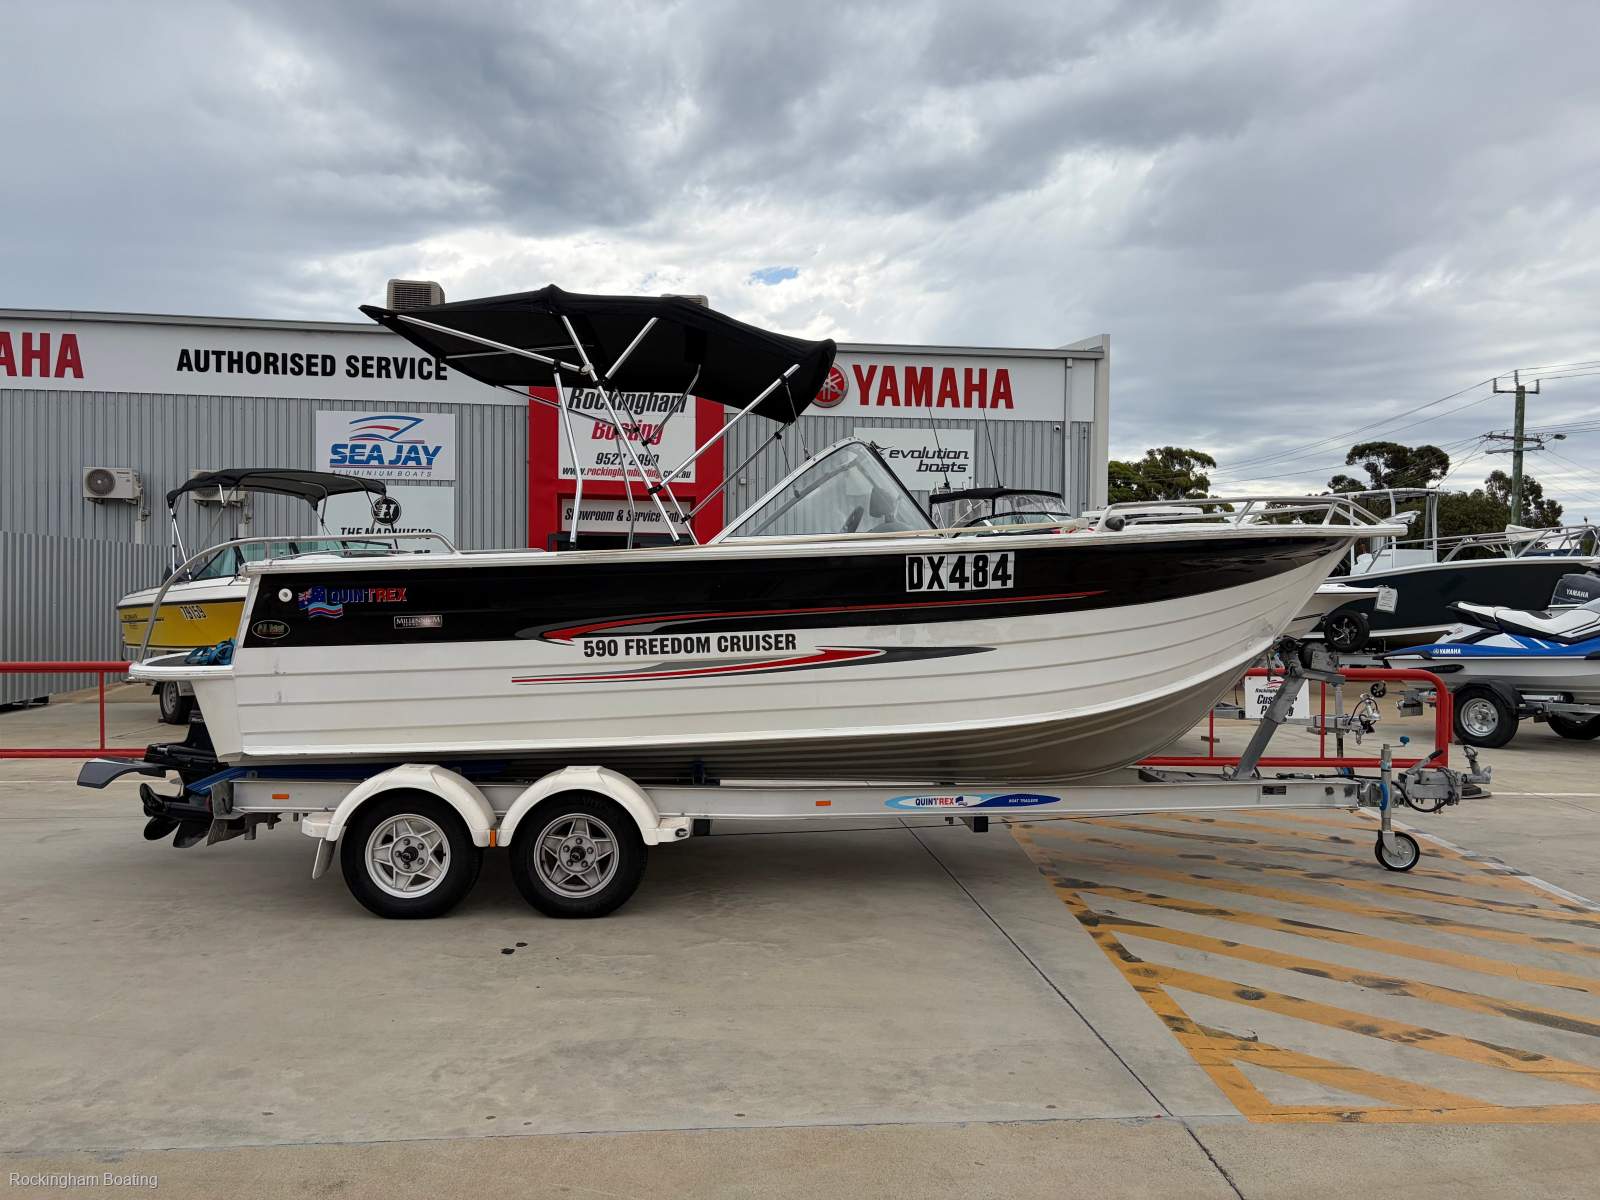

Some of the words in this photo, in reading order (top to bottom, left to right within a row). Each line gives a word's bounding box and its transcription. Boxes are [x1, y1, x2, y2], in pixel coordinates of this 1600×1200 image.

[176, 348, 336, 377] AUTHORISED
[345, 355, 447, 381] SERVICE
[852, 364, 1014, 409] YAMAHA
[330, 443, 384, 464] SEA
[388, 444, 442, 465] JAY
[889, 446, 969, 460] evolution
[916, 460, 968, 473] boats
[616, 509, 624, 522] &
[908, 553, 1012, 590] DX484
[331, 587, 407, 603] QUINTREX
[1566, 588, 1589, 598] YAMAHA
[584, 640, 618, 657] 590
[625, 636, 711, 656] FREEDOM
[717, 633, 797, 653] CRUISER
[915, 797, 954, 806] QUINTREX
